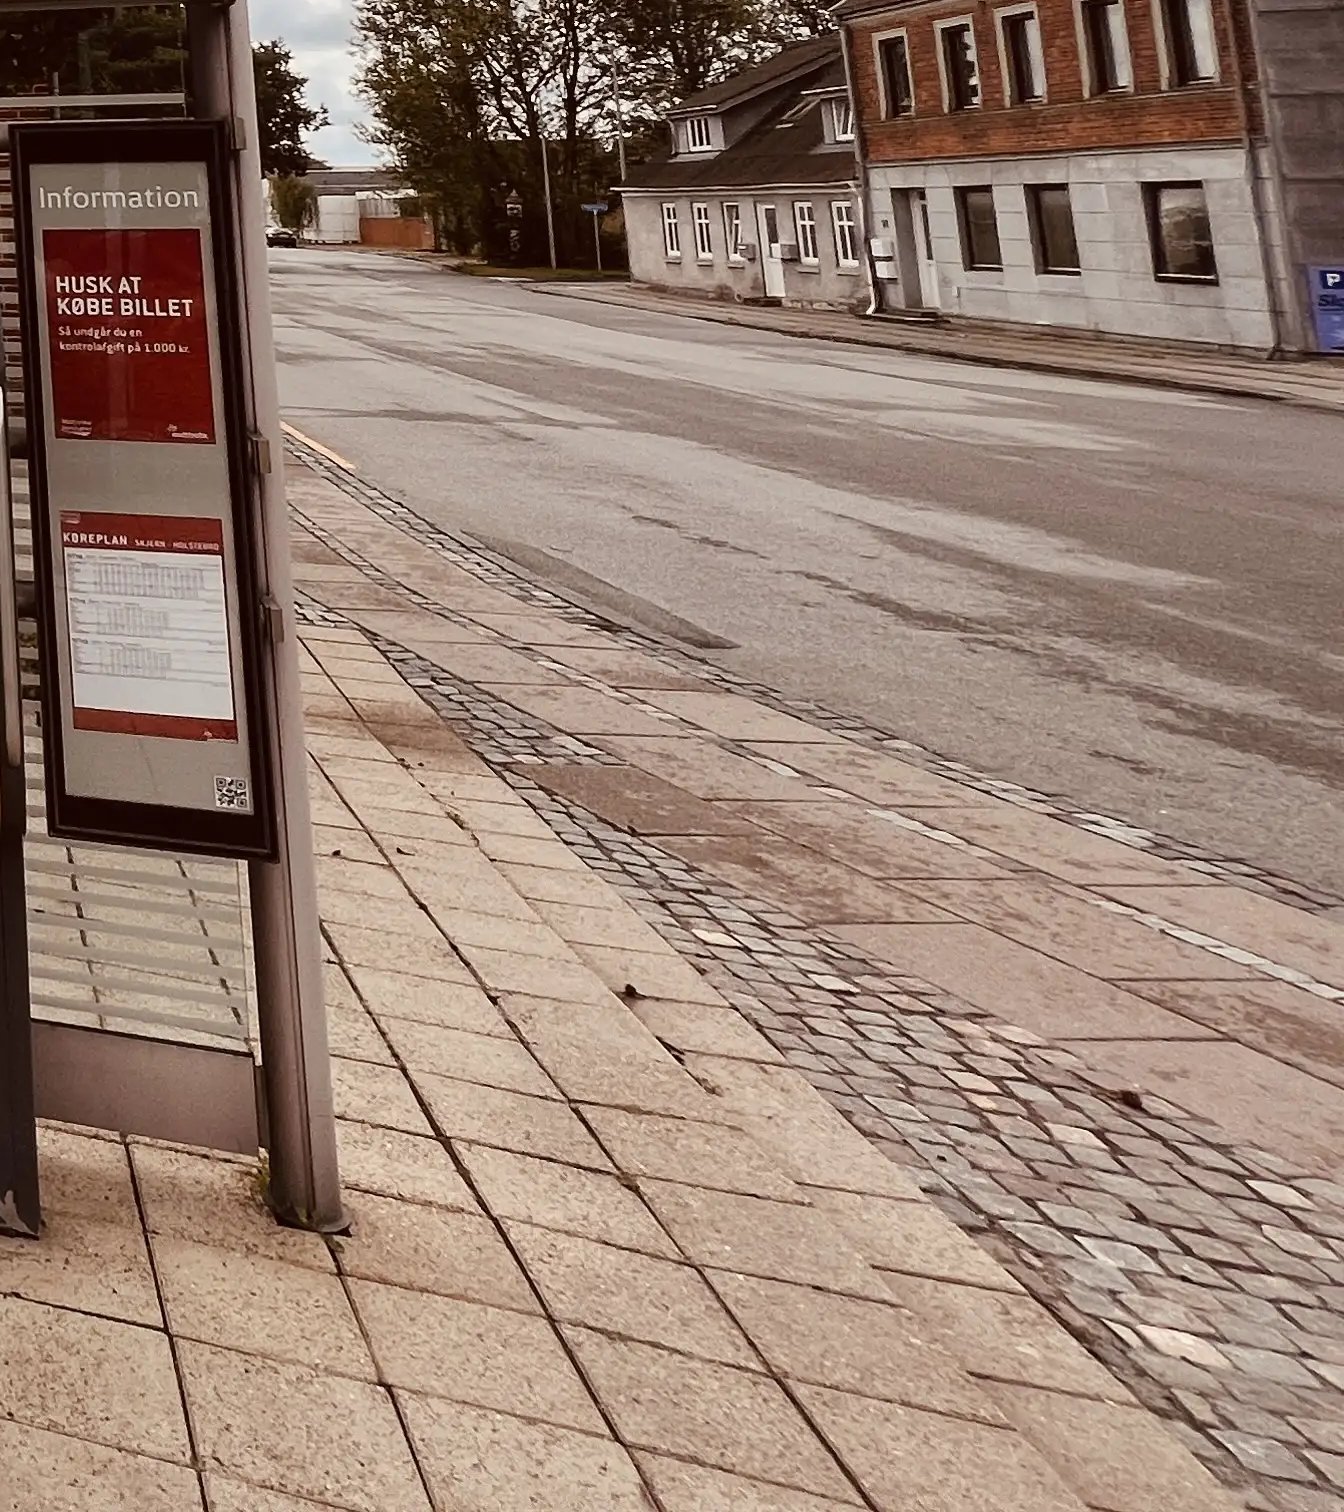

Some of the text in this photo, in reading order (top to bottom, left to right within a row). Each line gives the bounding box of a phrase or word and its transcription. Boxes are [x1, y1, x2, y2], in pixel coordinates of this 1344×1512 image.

[39, 186, 199, 210] Information
[56, 276, 141, 294] HUSK AT
[1326, 273, 1341, 287] P
[57, 297, 193, 317] KØBE BILLET
[58, 326, 143, 339] Så undgår du en
[59, 341, 125, 354] kontrolafgift
[127, 341, 141, 354] på
[144, 343, 176, 353] 1.000
